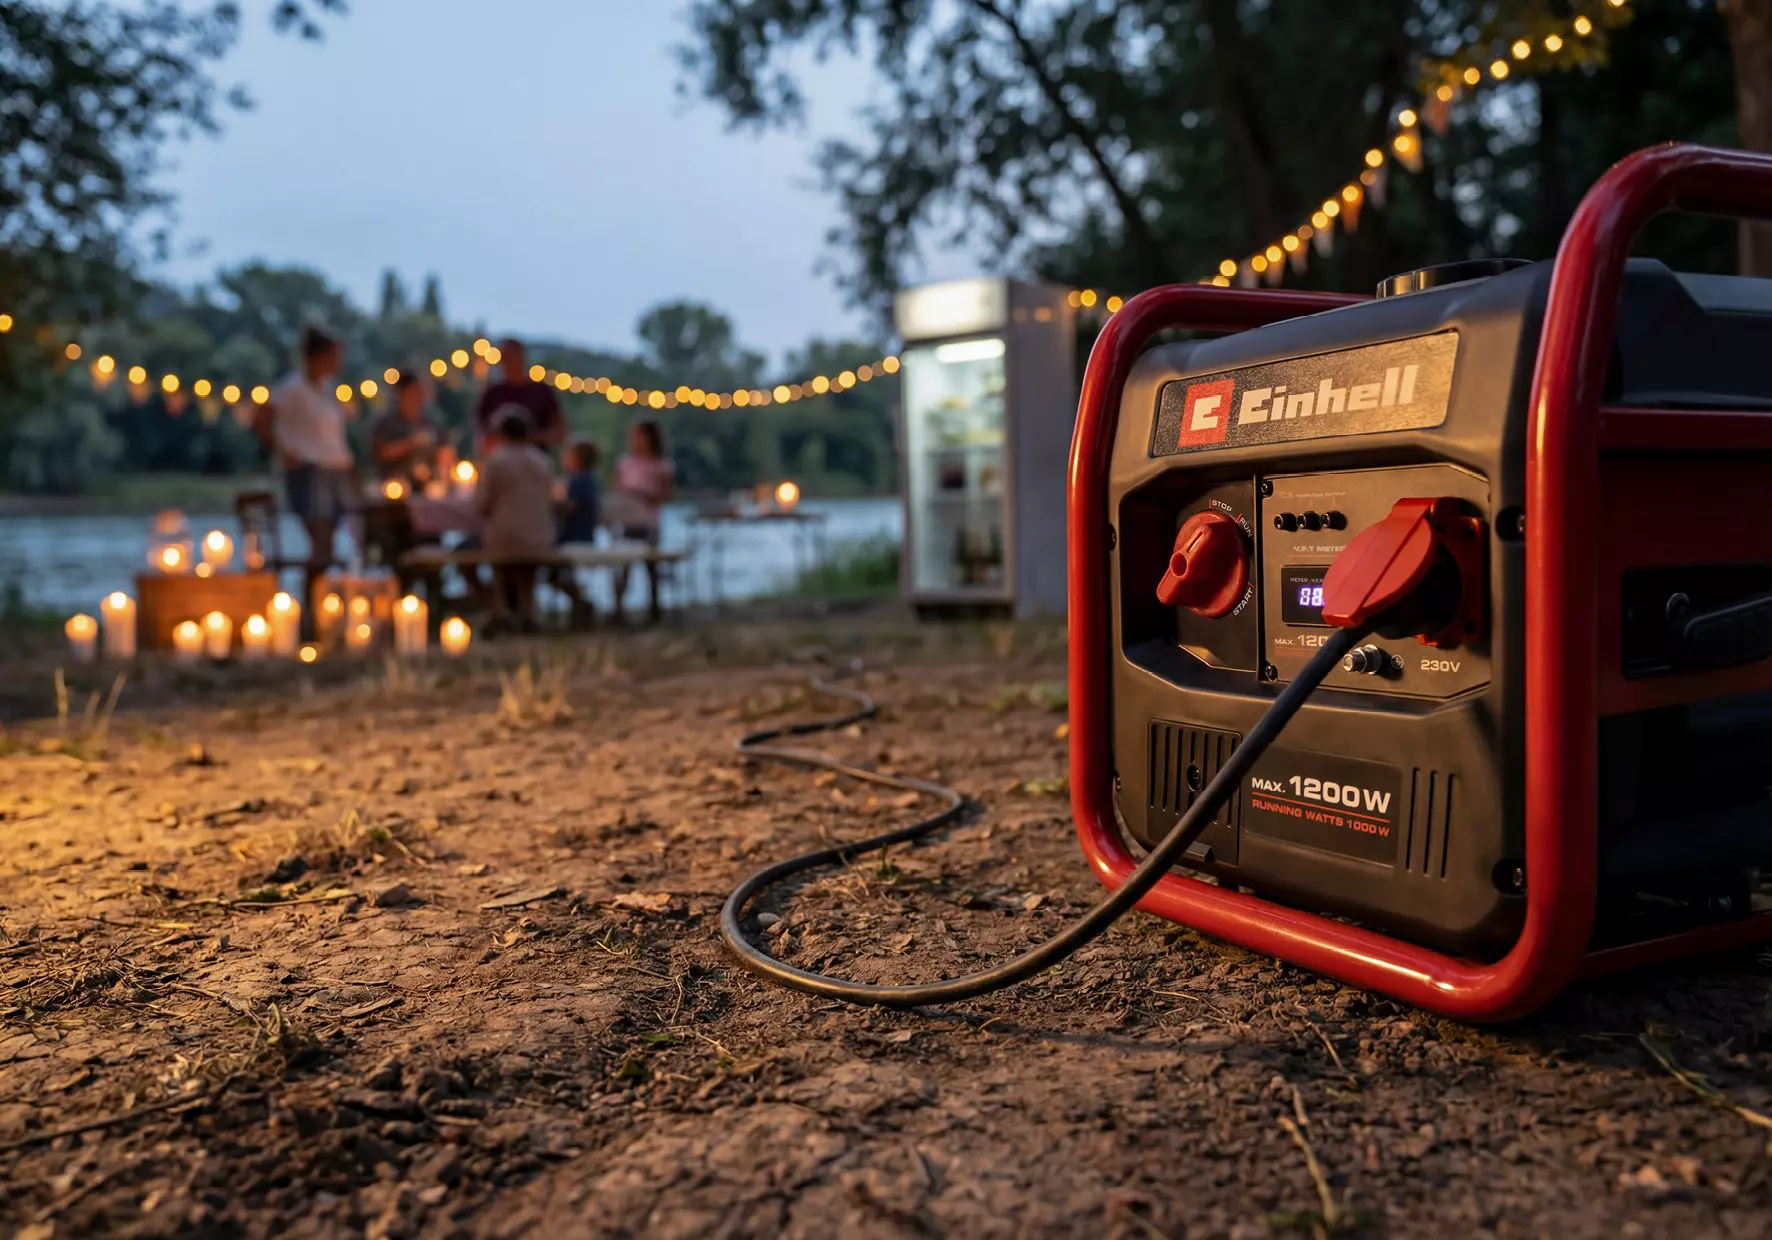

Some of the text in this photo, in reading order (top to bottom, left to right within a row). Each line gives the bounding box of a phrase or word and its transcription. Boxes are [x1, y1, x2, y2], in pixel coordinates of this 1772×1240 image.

[1238, 364, 1418, 425] Einhell
[1211, 499, 1233, 512] STOP
[1239, 517, 1252, 537] RUN
[1233, 587, 1253, 616] START
[1274, 638, 1296, 646] MAX.
[1420, 659, 1461, 673] 230V
[1252, 777, 1287, 794] MAX.
[1252, 799, 1302, 818] RUNNING
[1305, 809, 1344, 827] WATTS
